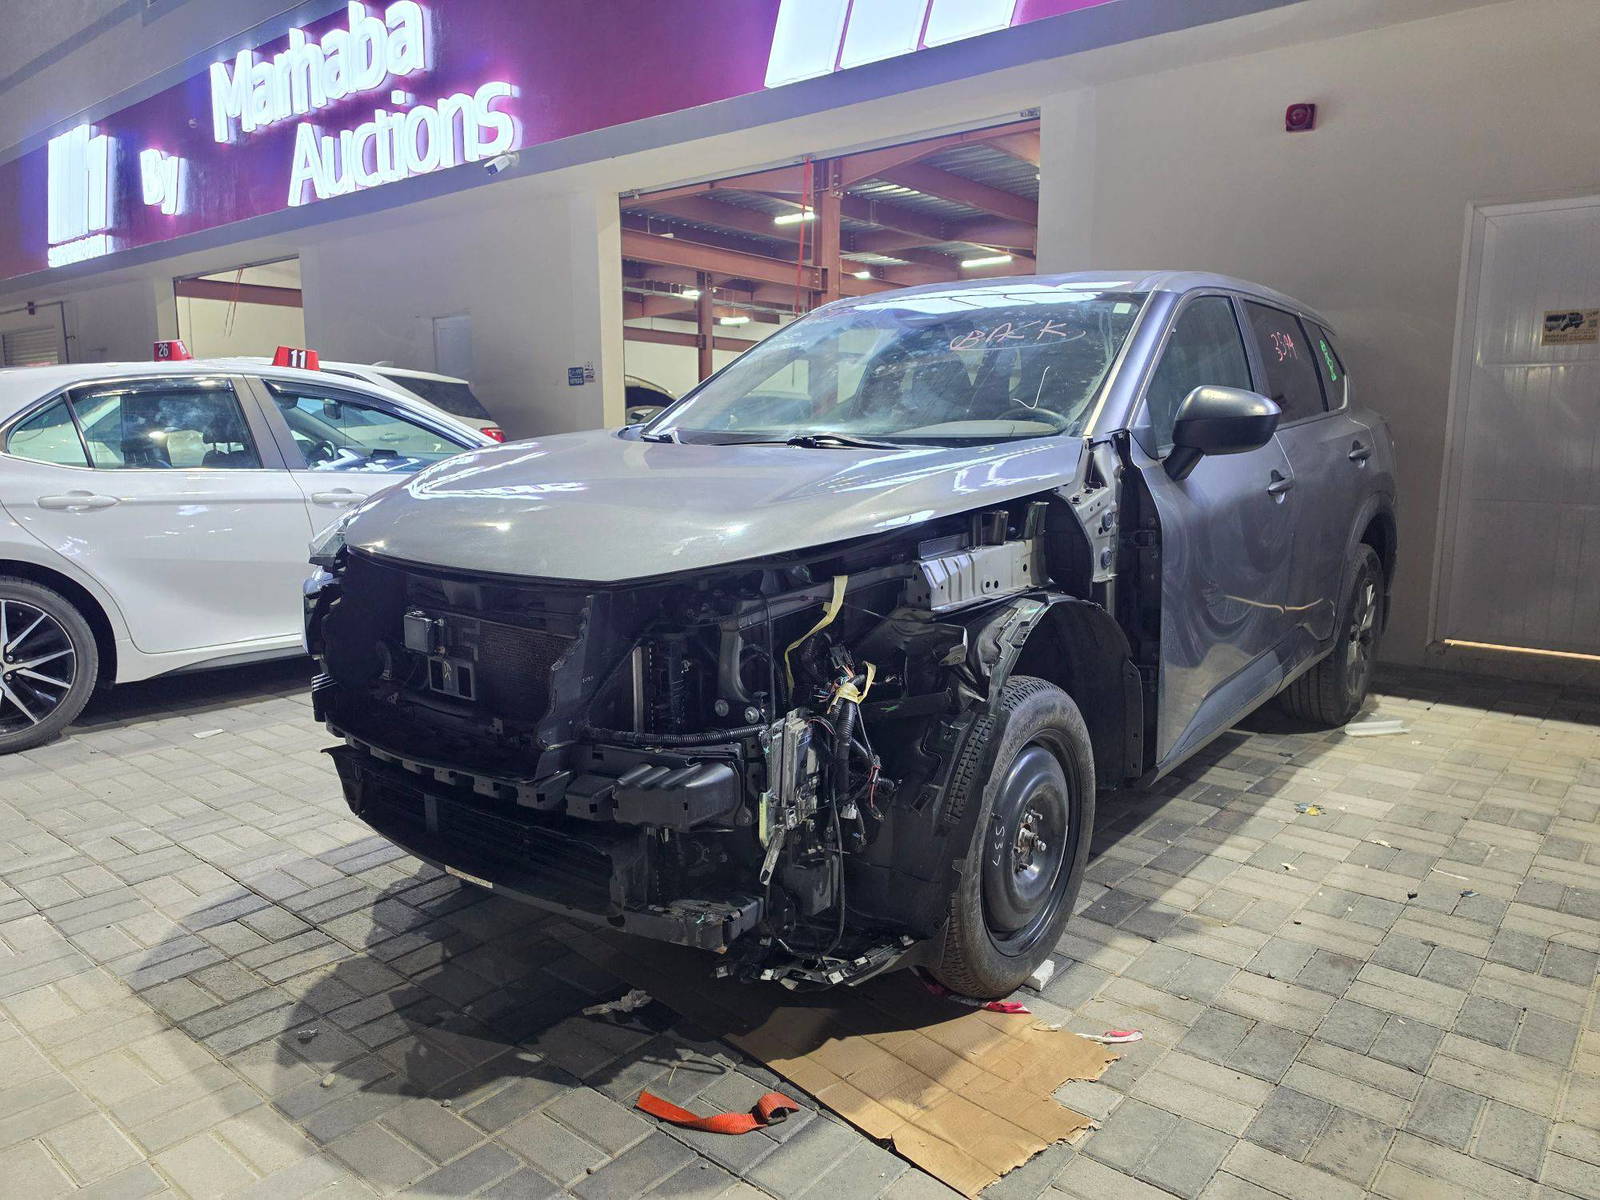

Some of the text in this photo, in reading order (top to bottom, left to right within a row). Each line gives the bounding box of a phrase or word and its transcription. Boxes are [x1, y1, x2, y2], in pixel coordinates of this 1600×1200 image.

[210, 0, 426, 143] Marhaba
[288, 81, 515, 207] Auctions
[140, 148, 179, 215] By
[158, 343, 169, 357] 26
[290, 349, 306, 368] 11
